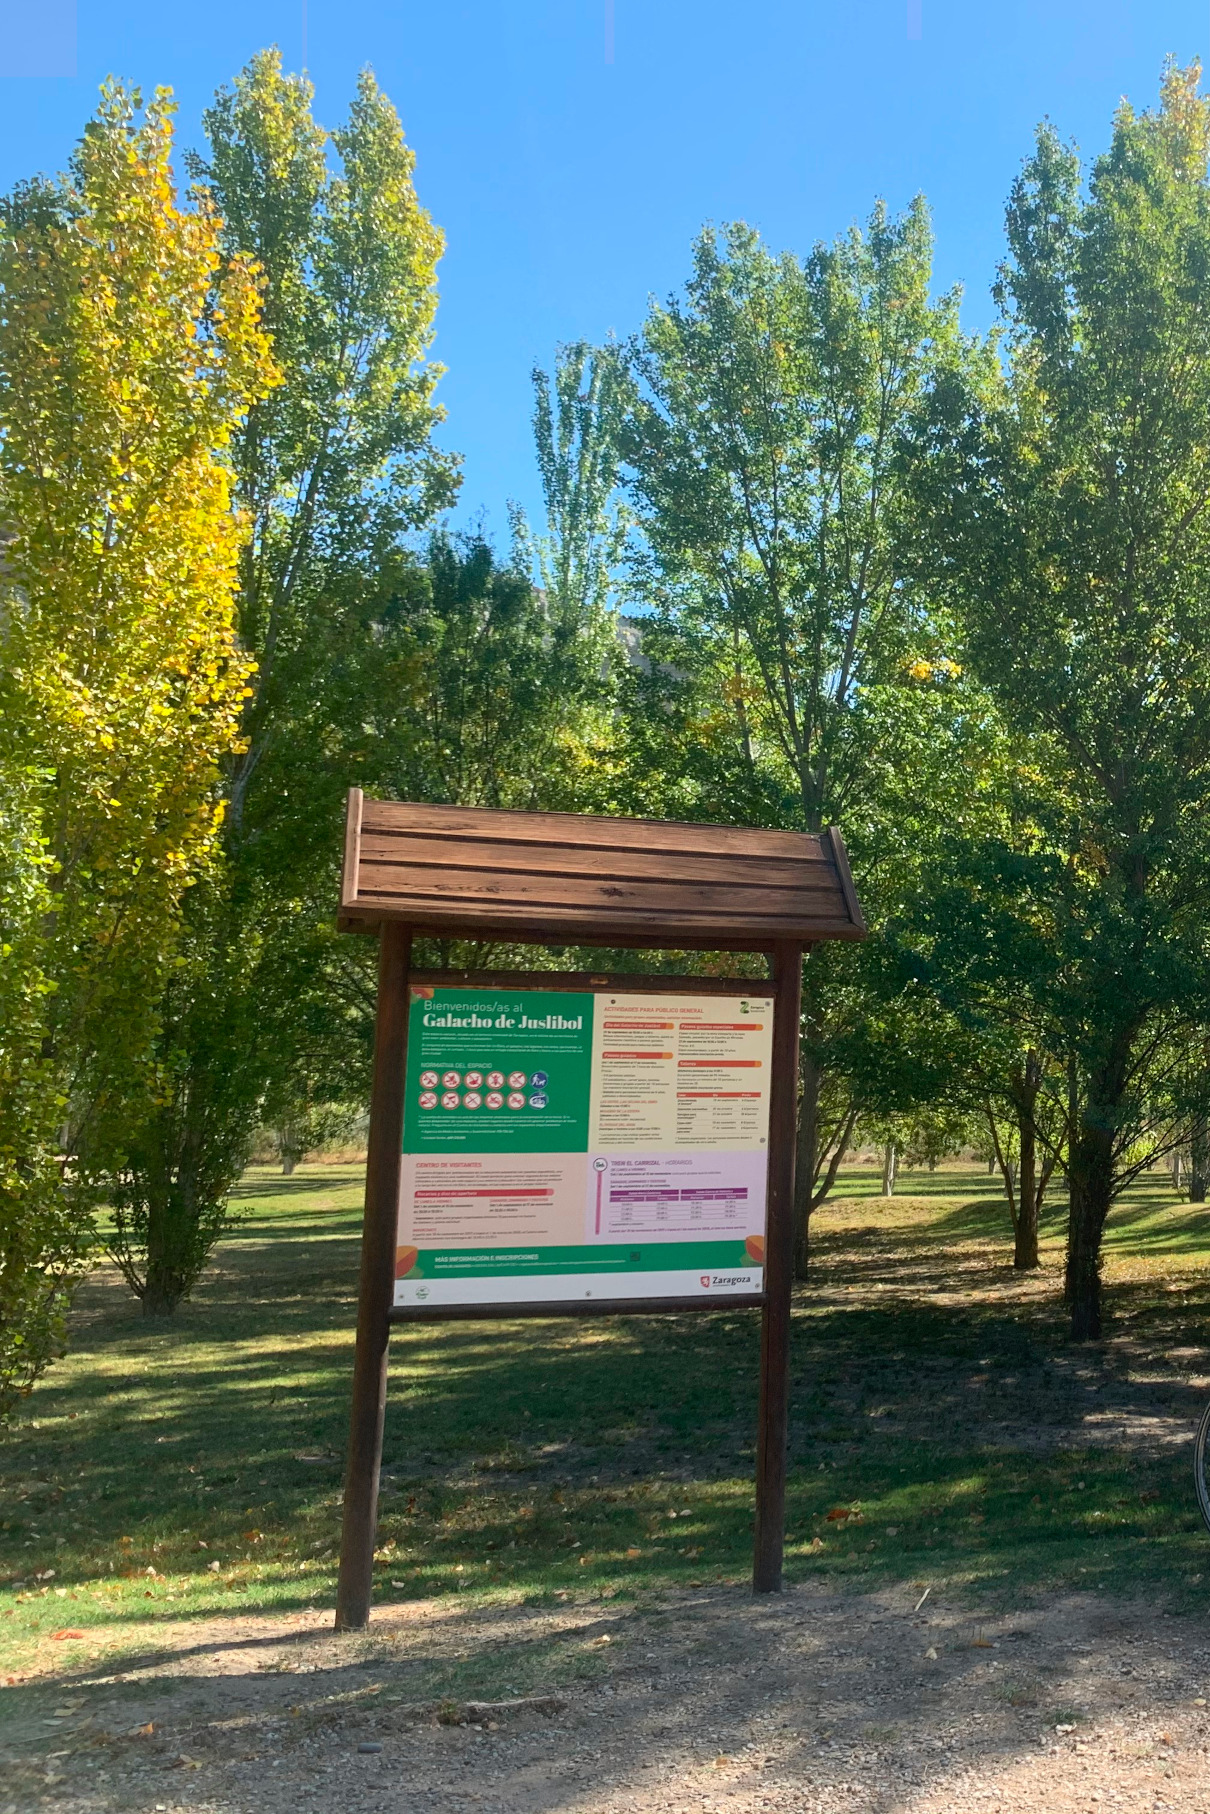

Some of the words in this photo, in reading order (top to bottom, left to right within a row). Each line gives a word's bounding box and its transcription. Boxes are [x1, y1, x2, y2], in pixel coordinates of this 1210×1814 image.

[424, 1000, 510, 1013] Bienvenidos/as
[513, 1003, 523, 1013] al
[422, 1013, 493, 1029] Galacho
[495, 1014, 516, 1029] de
[518, 1015, 583, 1030] Juslibol
[712, 1276, 751, 1286] Zaragoza
